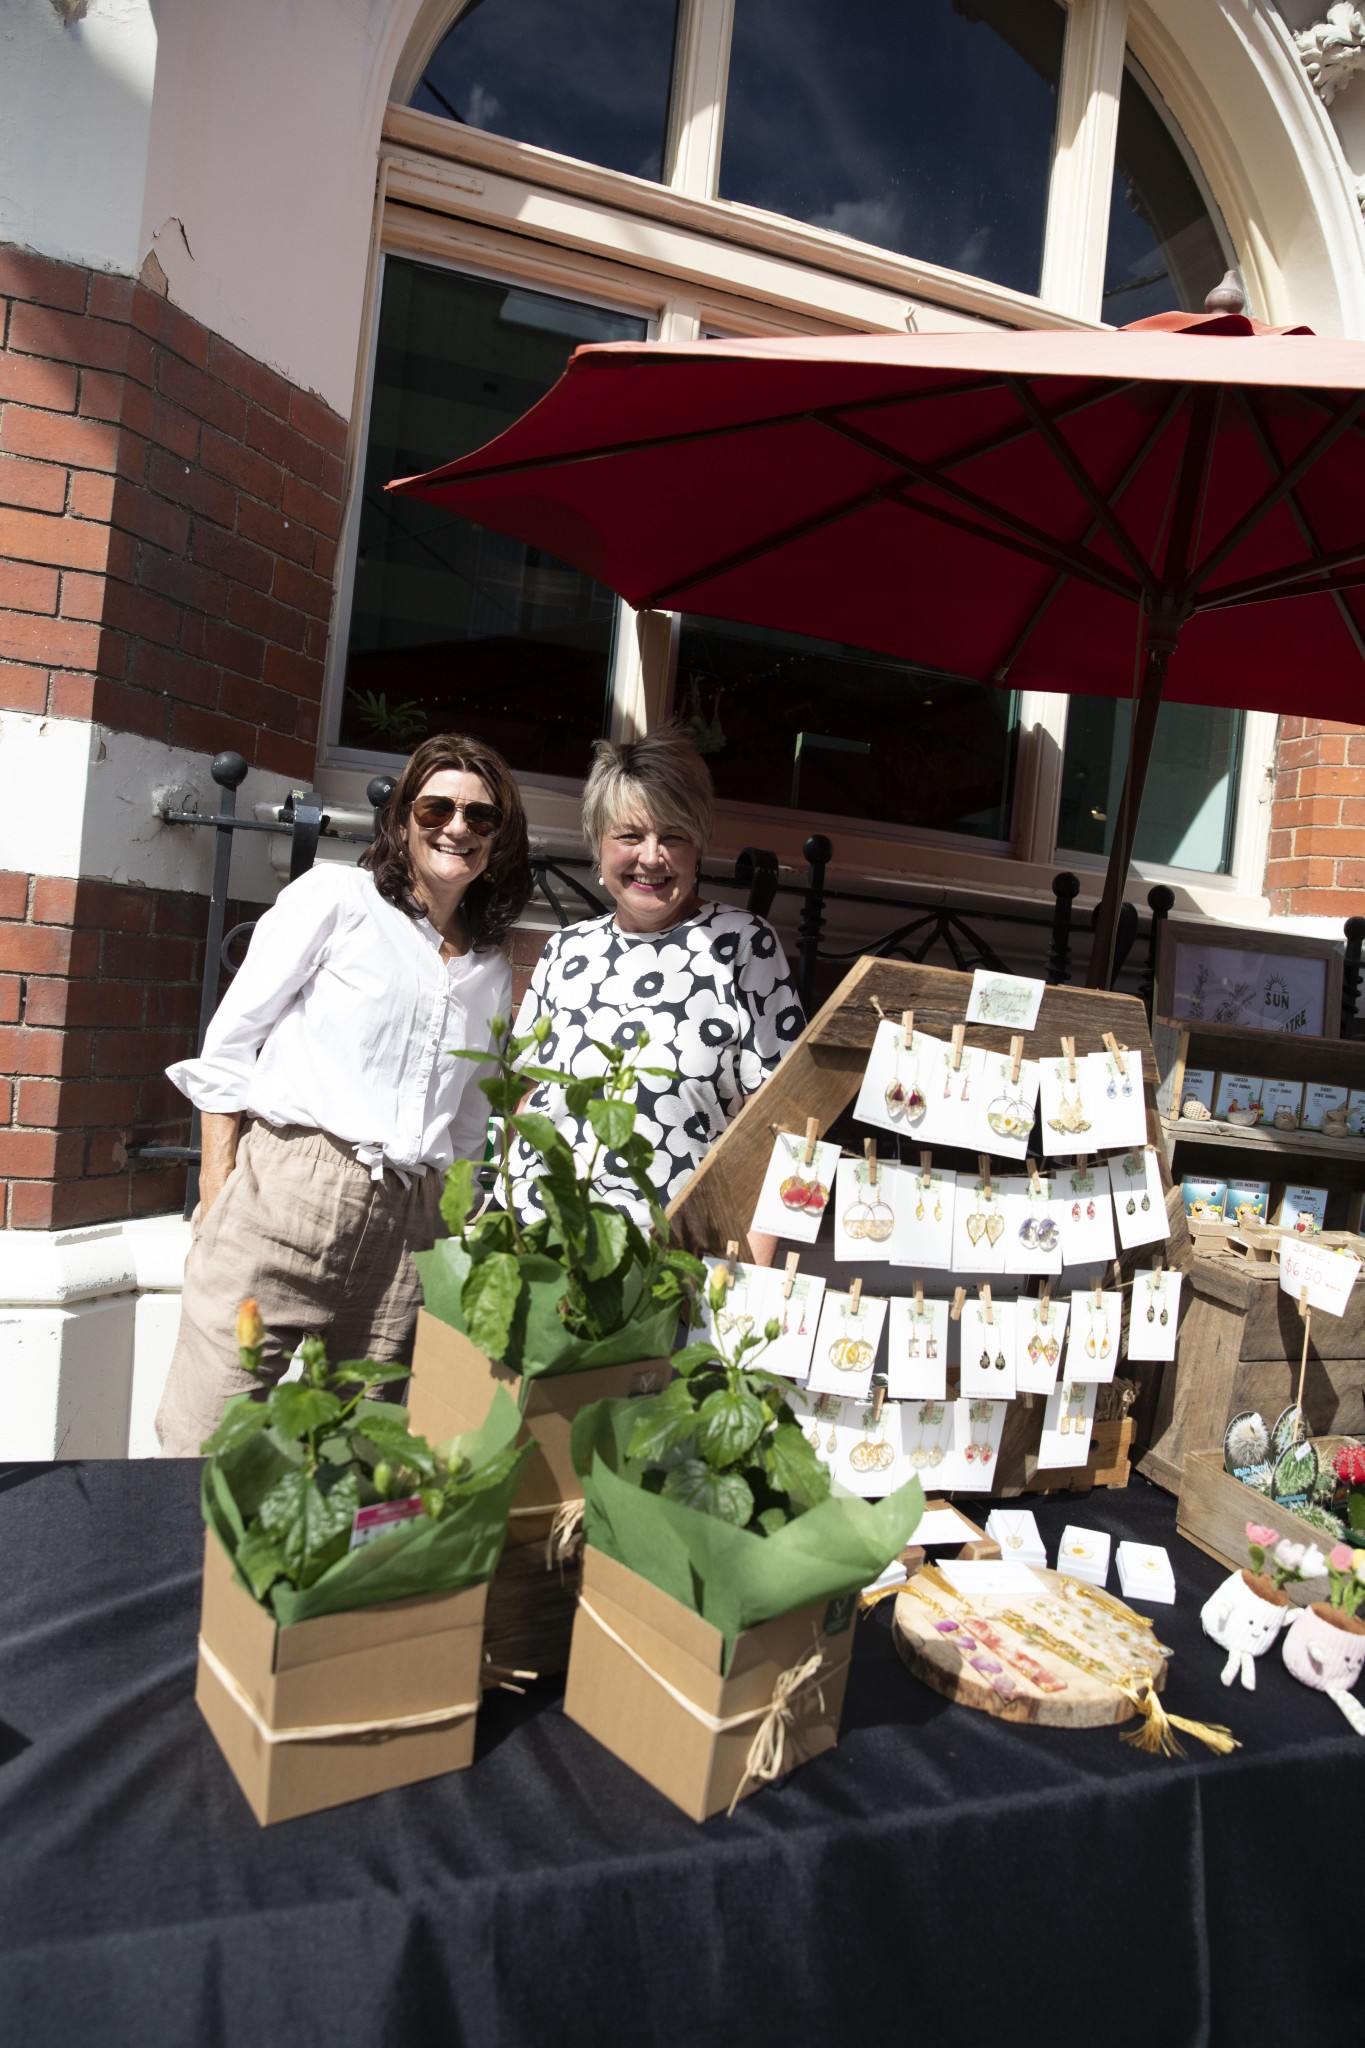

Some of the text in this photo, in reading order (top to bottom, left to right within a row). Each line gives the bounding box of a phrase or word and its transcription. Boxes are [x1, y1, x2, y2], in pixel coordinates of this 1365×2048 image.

[1265, 991, 1289, 1010] SUN
[1279, 1009, 1307, 1032] ATRE
[1292, 1242, 1332, 1265] SALE!
